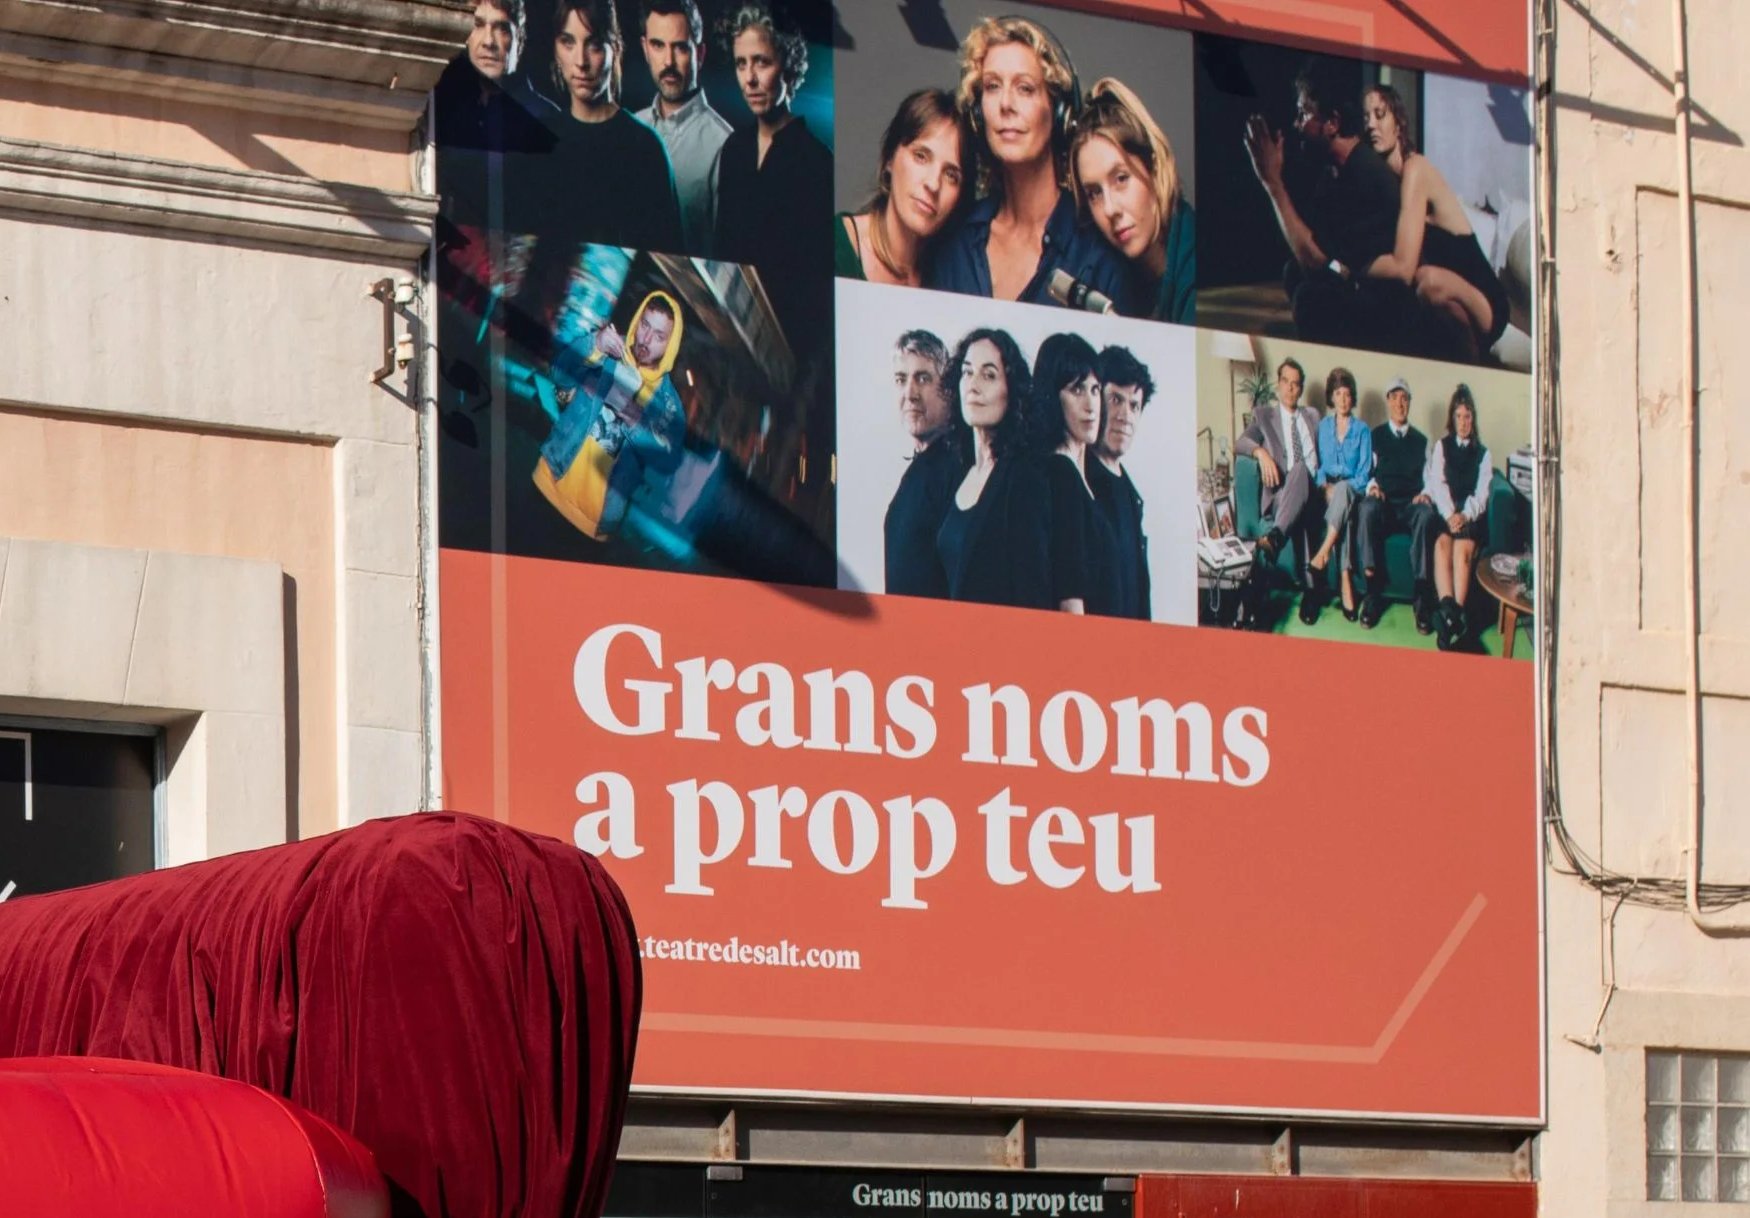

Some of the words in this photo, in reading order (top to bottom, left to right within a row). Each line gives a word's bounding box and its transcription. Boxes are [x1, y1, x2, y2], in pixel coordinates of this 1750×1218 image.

[573, 623, 937, 760] Grans
[961, 682, 1271, 788] noms
[573, 771, 644, 860] a
[665, 777, 958, 910] prop
[978, 786, 1162, 894] teu
[638, 936, 861, 970] .teatredesalt.com
[852, 1183, 921, 1207] Grans
[927, 1190, 991, 1211] noms
[995, 1193, 1008, 1210] a
[1011, 1191, 1066, 1217] prop
[1069, 1191, 1104, 1212] teu
